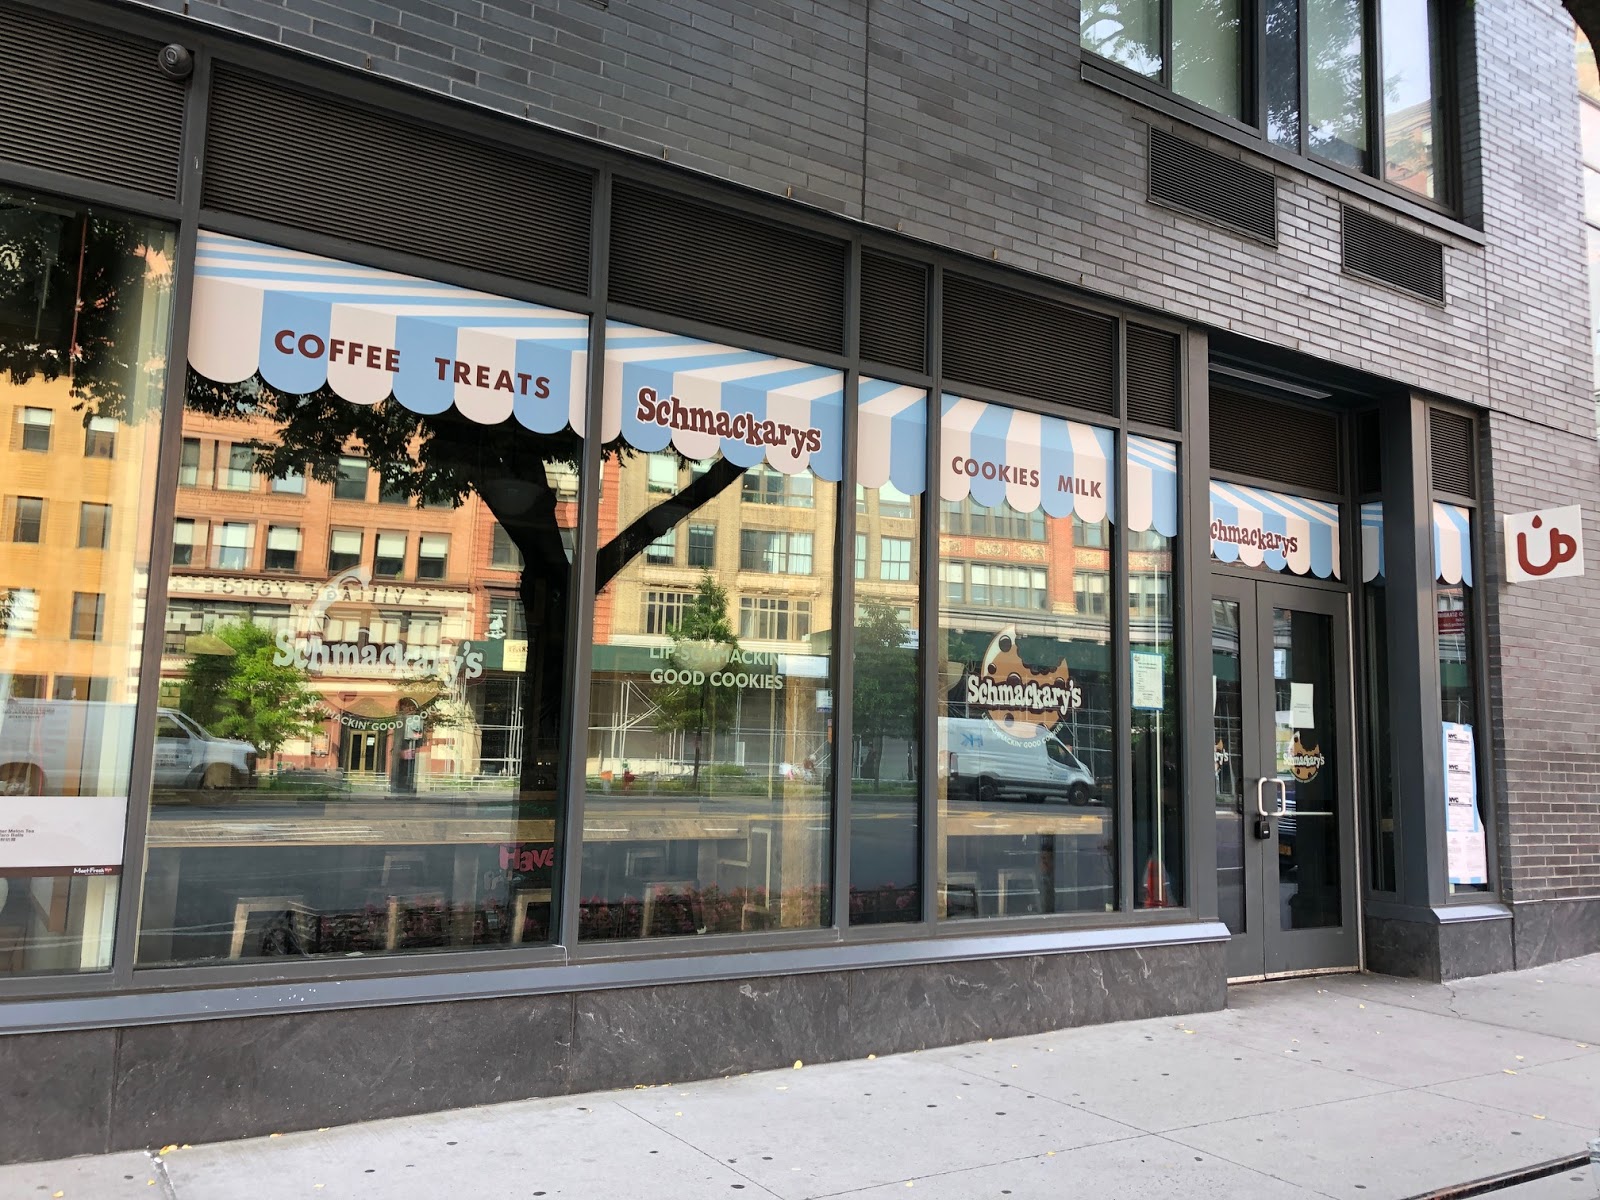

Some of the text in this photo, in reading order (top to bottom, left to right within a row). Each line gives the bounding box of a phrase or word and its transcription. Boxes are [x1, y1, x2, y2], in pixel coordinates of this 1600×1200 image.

[274, 329, 550, 399] COFFEE TREATS
[637, 387, 821, 459] Schmackarys
[951, 456, 1102, 499] COOKIES MILK
[1210, 519, 1298, 558] chmackarys
[273, 627, 484, 689] Schmackary's
[650, 668, 784, 690] GOOD COOKIES
[967, 674, 1082, 715] Schmackary's
[371, 720, 404, 731] GOOD
[405, 705, 437, 726] COOKI
[1023, 740, 1042, 749] GOOD
[1282, 752, 1325, 769] Schmackary's
[499, 846, 555, 872] Have
